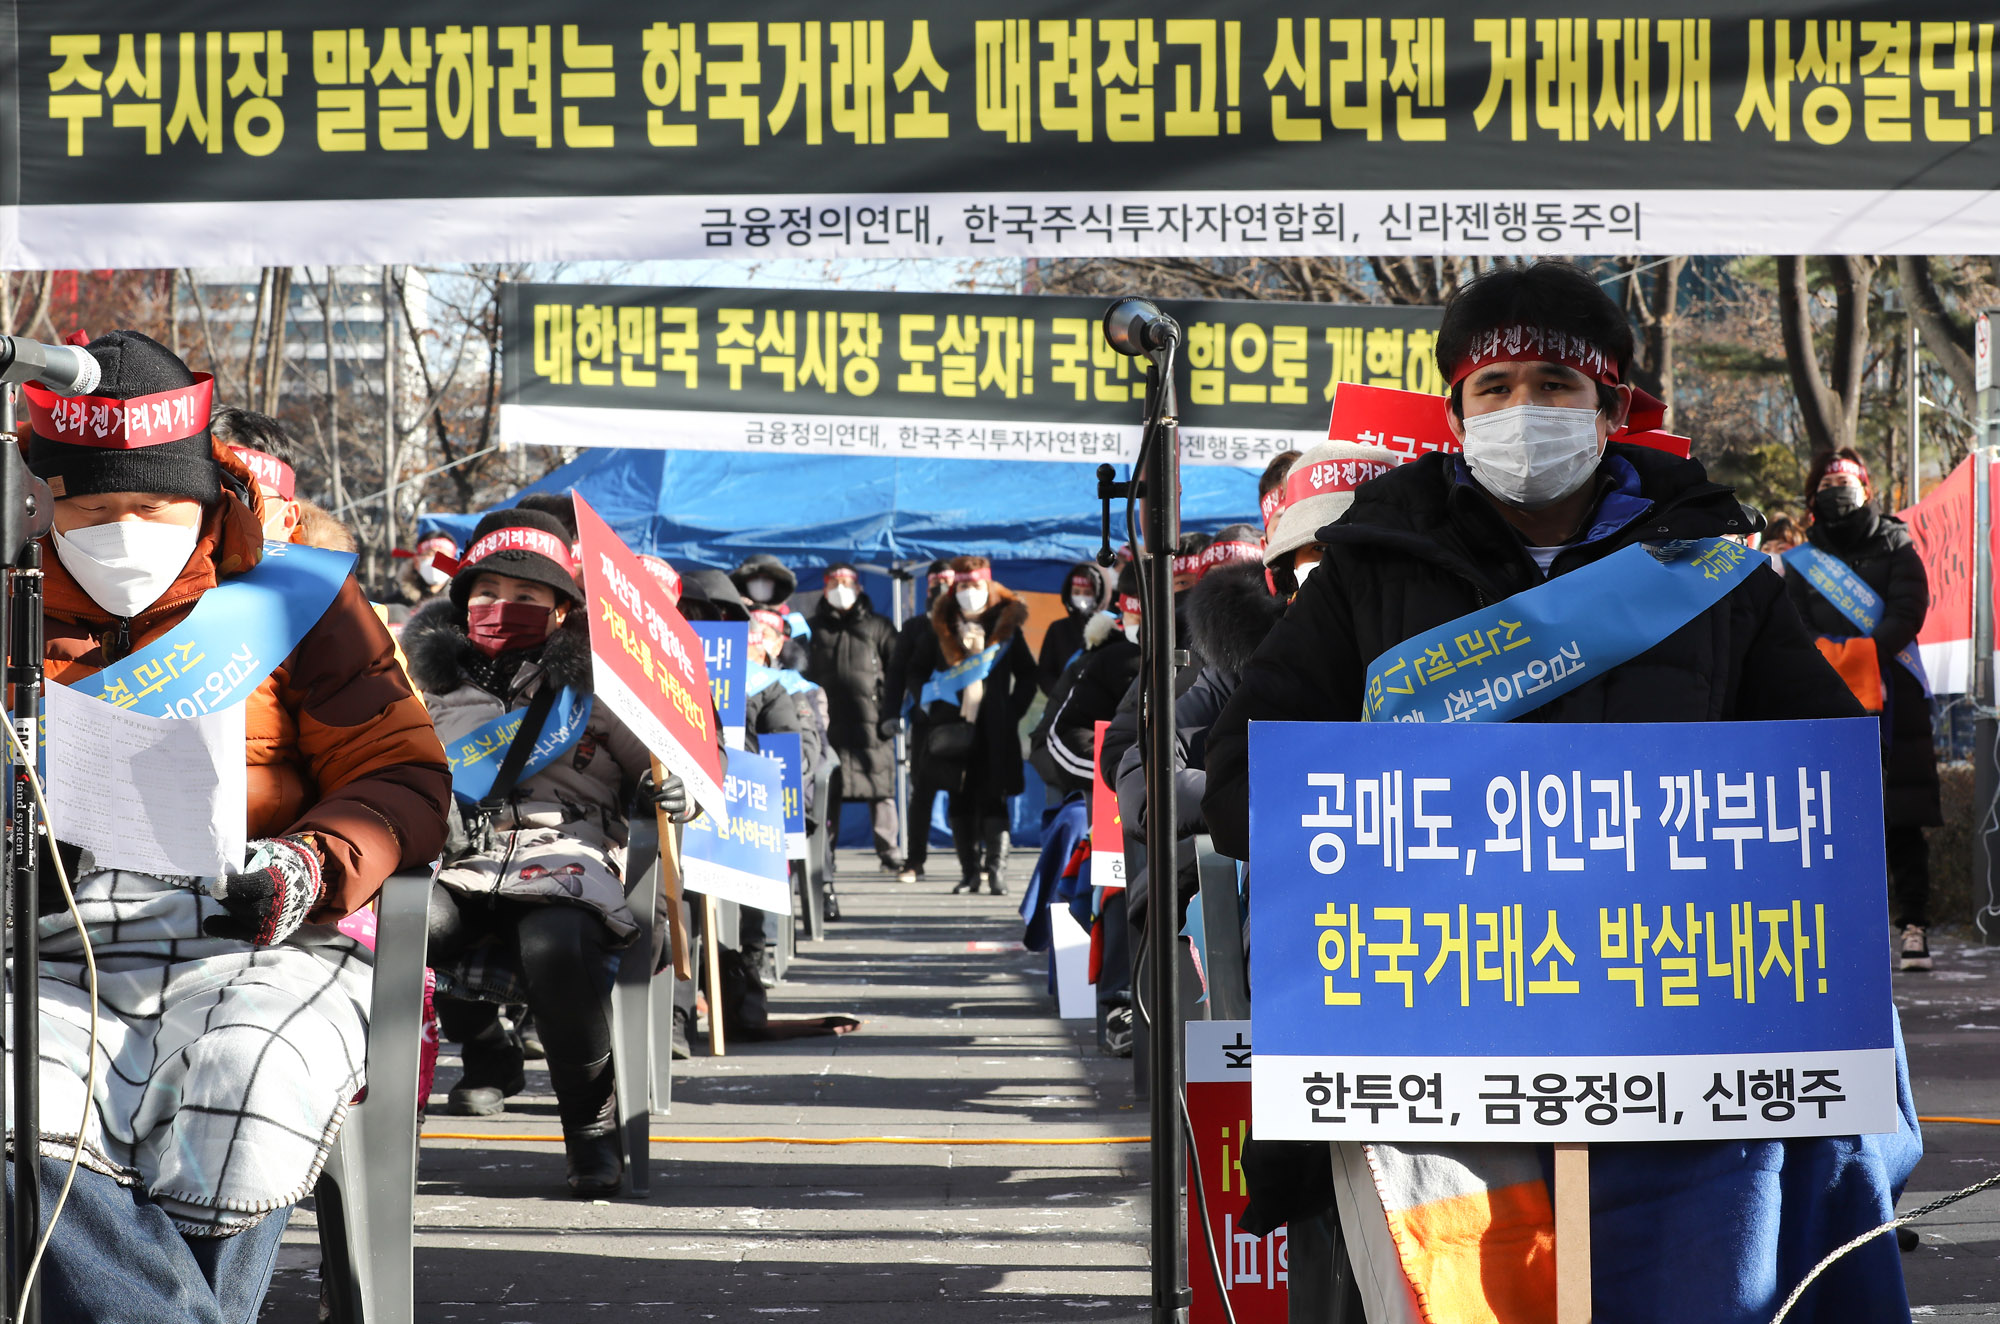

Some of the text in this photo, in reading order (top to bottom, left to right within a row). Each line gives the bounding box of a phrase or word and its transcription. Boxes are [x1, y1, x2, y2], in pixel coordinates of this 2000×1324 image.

[48, 17, 1995, 157] 주식시장 말살하려는 한국거래소 때려잡고! 신라젠 거래재개 사생결단!
[701, 202, 1643, 248] 금융정의연대, 한국주식투자자연합회, 신라젠행동주의
[533, 303, 700, 389] 대한민국
[715, 308, 884, 398] 주식시장
[898, 313, 1036, 399] 도살자!
[1187, 321, 1309, 406] 힘으로
[50, 393, 196, 441] 신라젠거래재개!
[745, 421, 888, 450] 금융정의연대,
[898, 425, 1130, 456] 한국주식투자자연합회,
[600, 551, 643, 621] 재산권
[644, 600, 696, 685] 강탈하는
[1412, 619, 1532, 686] 신라젠
[600, 596, 656, 683] 거래소를
[656, 671, 709, 743] 규탄한다
[14, 774, 30, 856] Stand system
[1659, 766, 1834, 872] 깐부냐!
[1314, 900, 1828, 1008] 한국거래소 박살내자!
[1302, 1068, 1847, 1127] 한투연, 금융정의, 신행주
